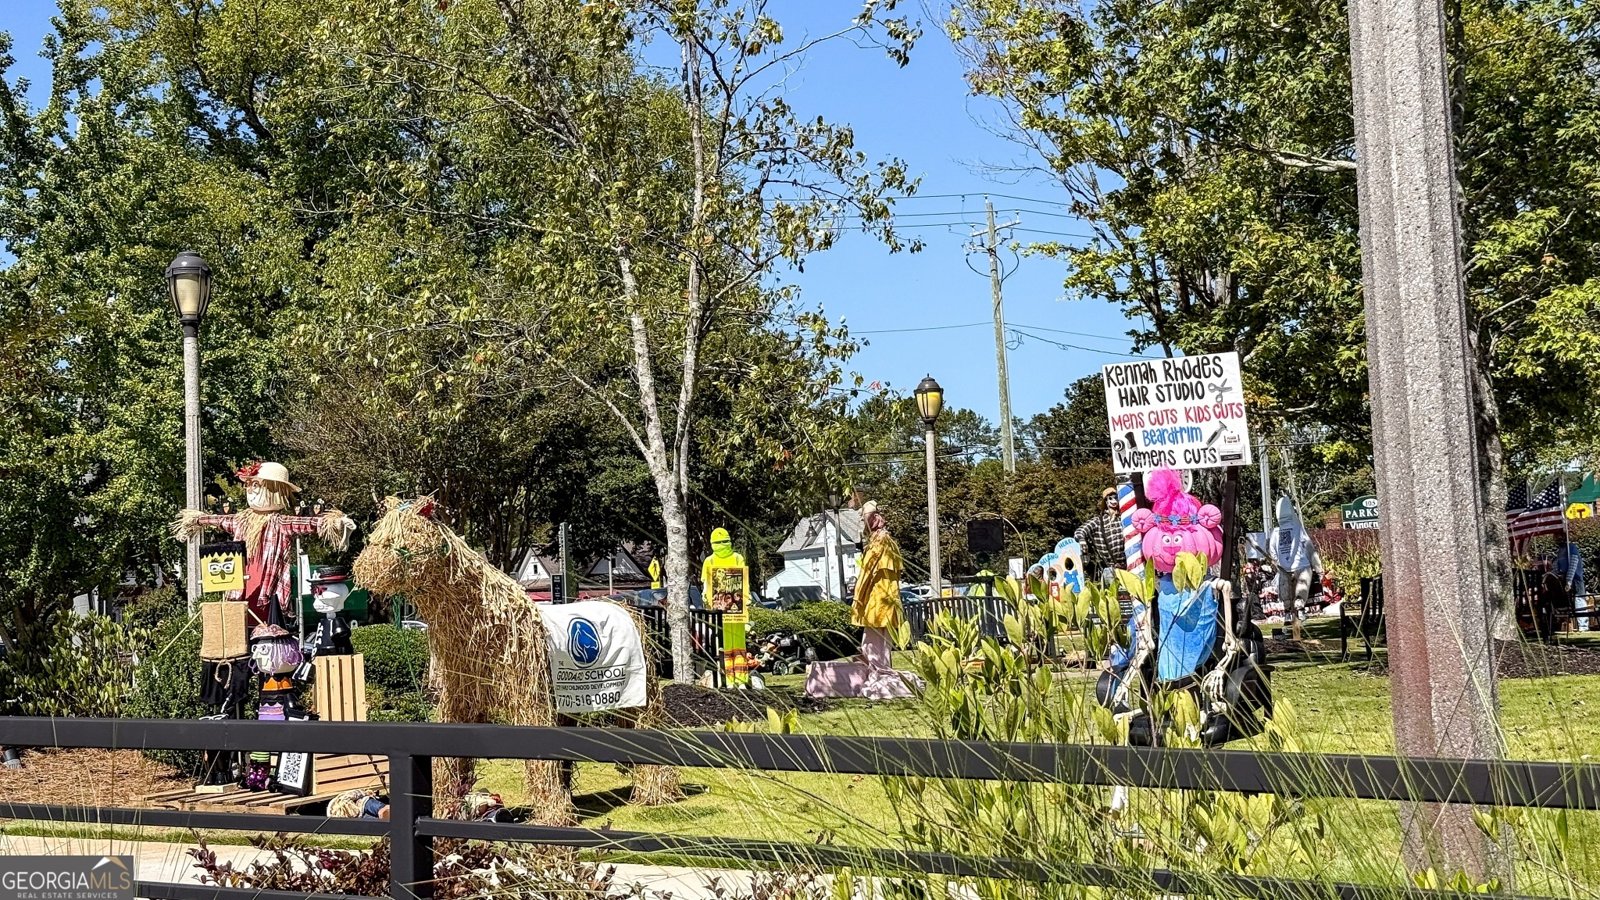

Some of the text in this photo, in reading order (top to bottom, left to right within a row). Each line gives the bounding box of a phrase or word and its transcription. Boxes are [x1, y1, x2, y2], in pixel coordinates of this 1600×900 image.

[1118, 380, 1205, 407] HAIR STUDIO
[1148, 408, 1178, 427] CUTS
[1184, 404, 1211, 423] KIDS
[1212, 402, 1243, 420] CUTS
[1184, 447, 1218, 464] CUTS
[584, 667, 626, 680] SCHOOL
